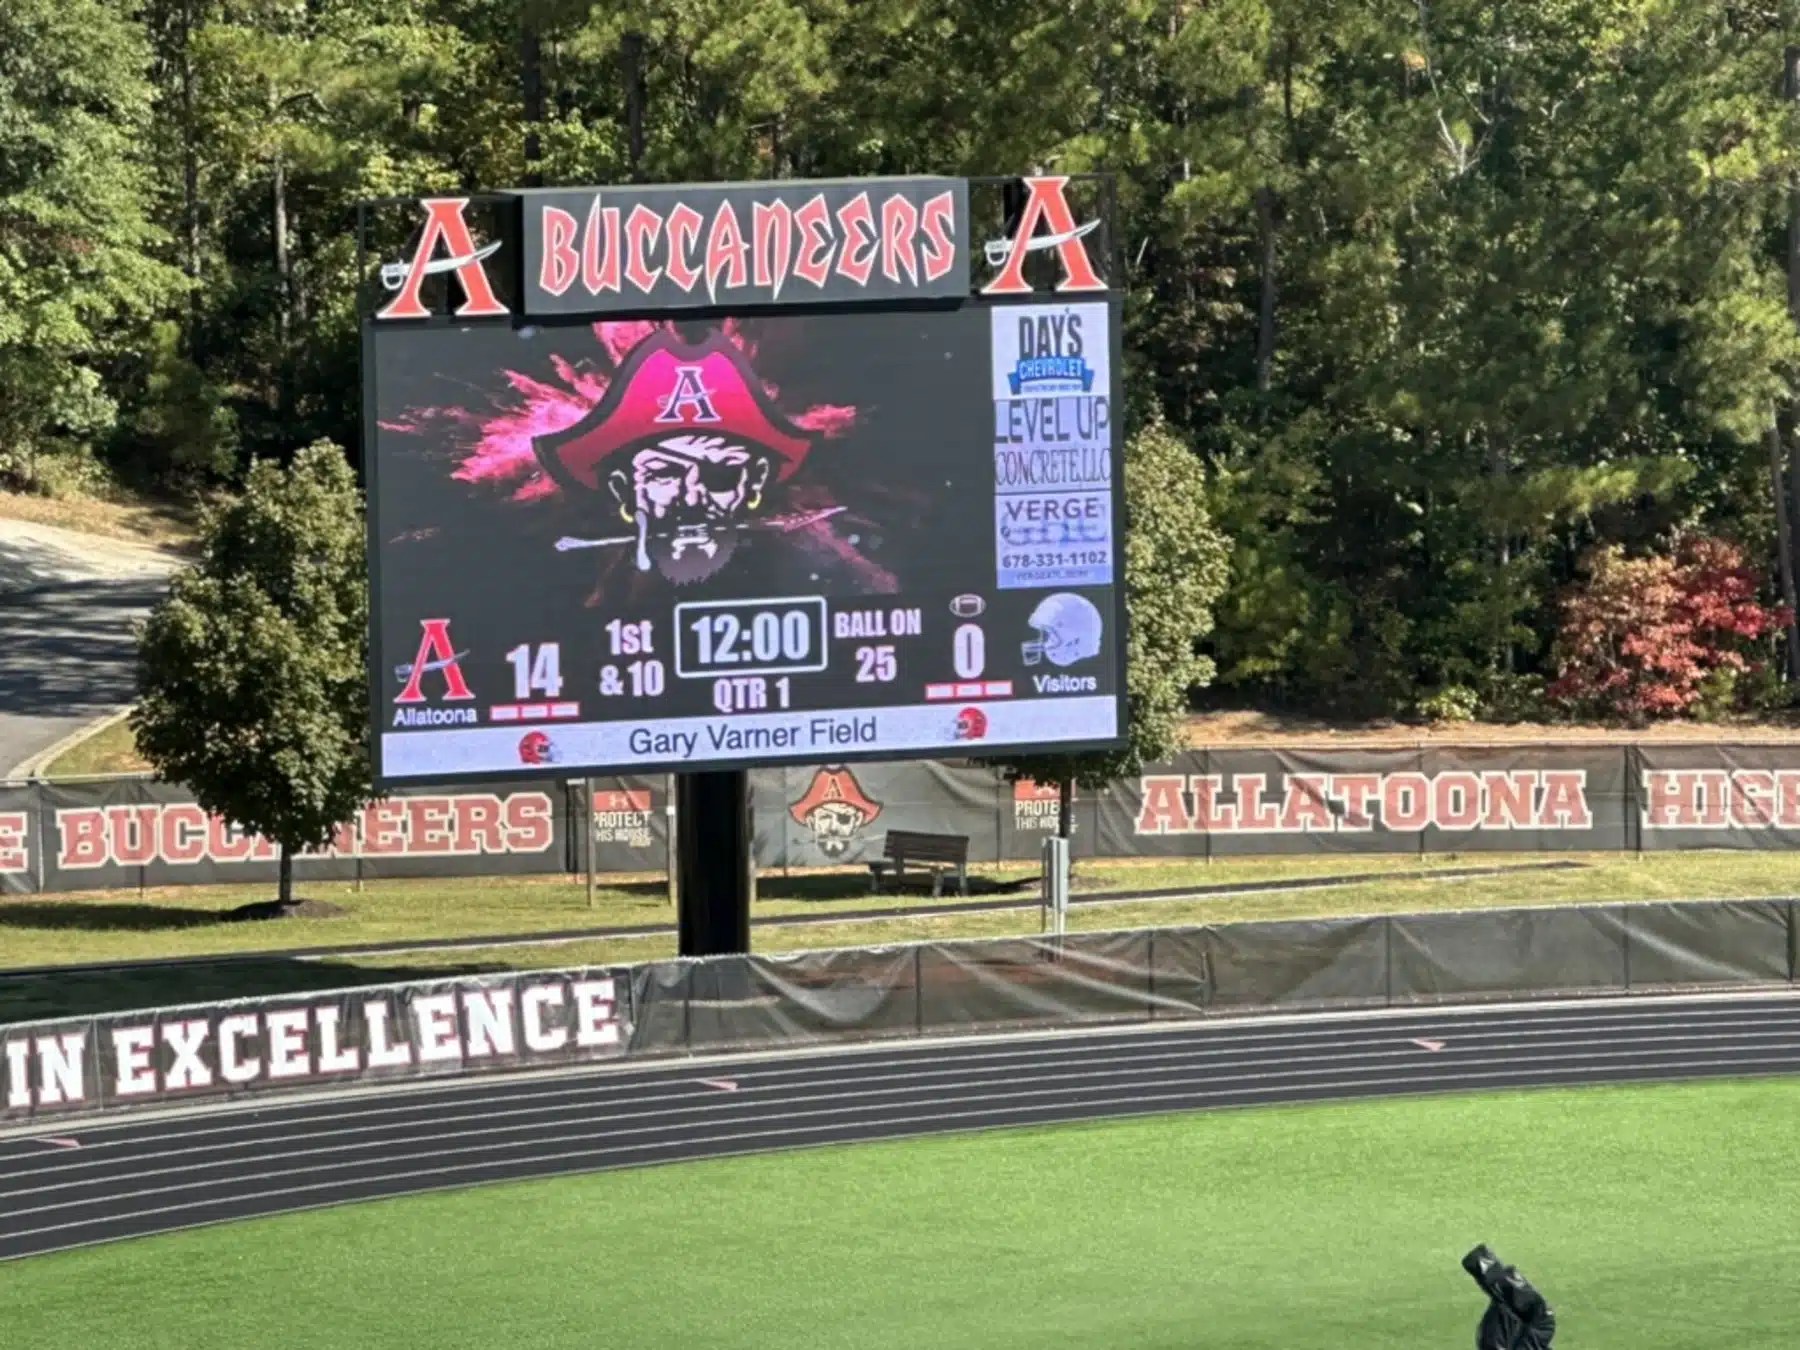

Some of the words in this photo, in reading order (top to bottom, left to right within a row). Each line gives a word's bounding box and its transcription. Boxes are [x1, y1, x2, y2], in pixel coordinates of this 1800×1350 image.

[376, 197, 510, 318] A
[539, 191, 957, 304] BUCCANEERS
[980, 176, 1109, 293] A
[1018, 306, 1083, 359] DAY'S
[1019, 358, 1083, 380] CHEVROLET
[654, 365, 722, 423] A
[1076, 395, 1110, 440] UP
[1005, 497, 1100, 521] VERGE
[1002, 550, 1107, 569] 678-331-1102
[605, 619, 654, 656] 1st
[691, 610, 810, 664] 12:00
[834, 610, 888, 639] BALL
[893, 608, 921, 636] ON
[393, 618, 476, 703] A
[505, 643, 564, 700] 14
[855, 645, 897, 683] 25
[953, 623, 985, 679] 0
[626, 659, 665, 697] 10
[713, 678, 767, 715] QTR
[775, 677, 791, 709] 1
[1032, 673, 1097, 693] Visitors
[392, 706, 479, 727] Allatoona
[629, 727, 698, 758] Gary
[707, 723, 801, 752] Varner
[810, 717, 877, 745] Field
[1134, 769, 1594, 835] ALLATOONA
[56, 792, 552, 869] BUCCEERS
[5, 1036, 86, 1107] IN
[113, 979, 620, 1096] EXCELLENCE
